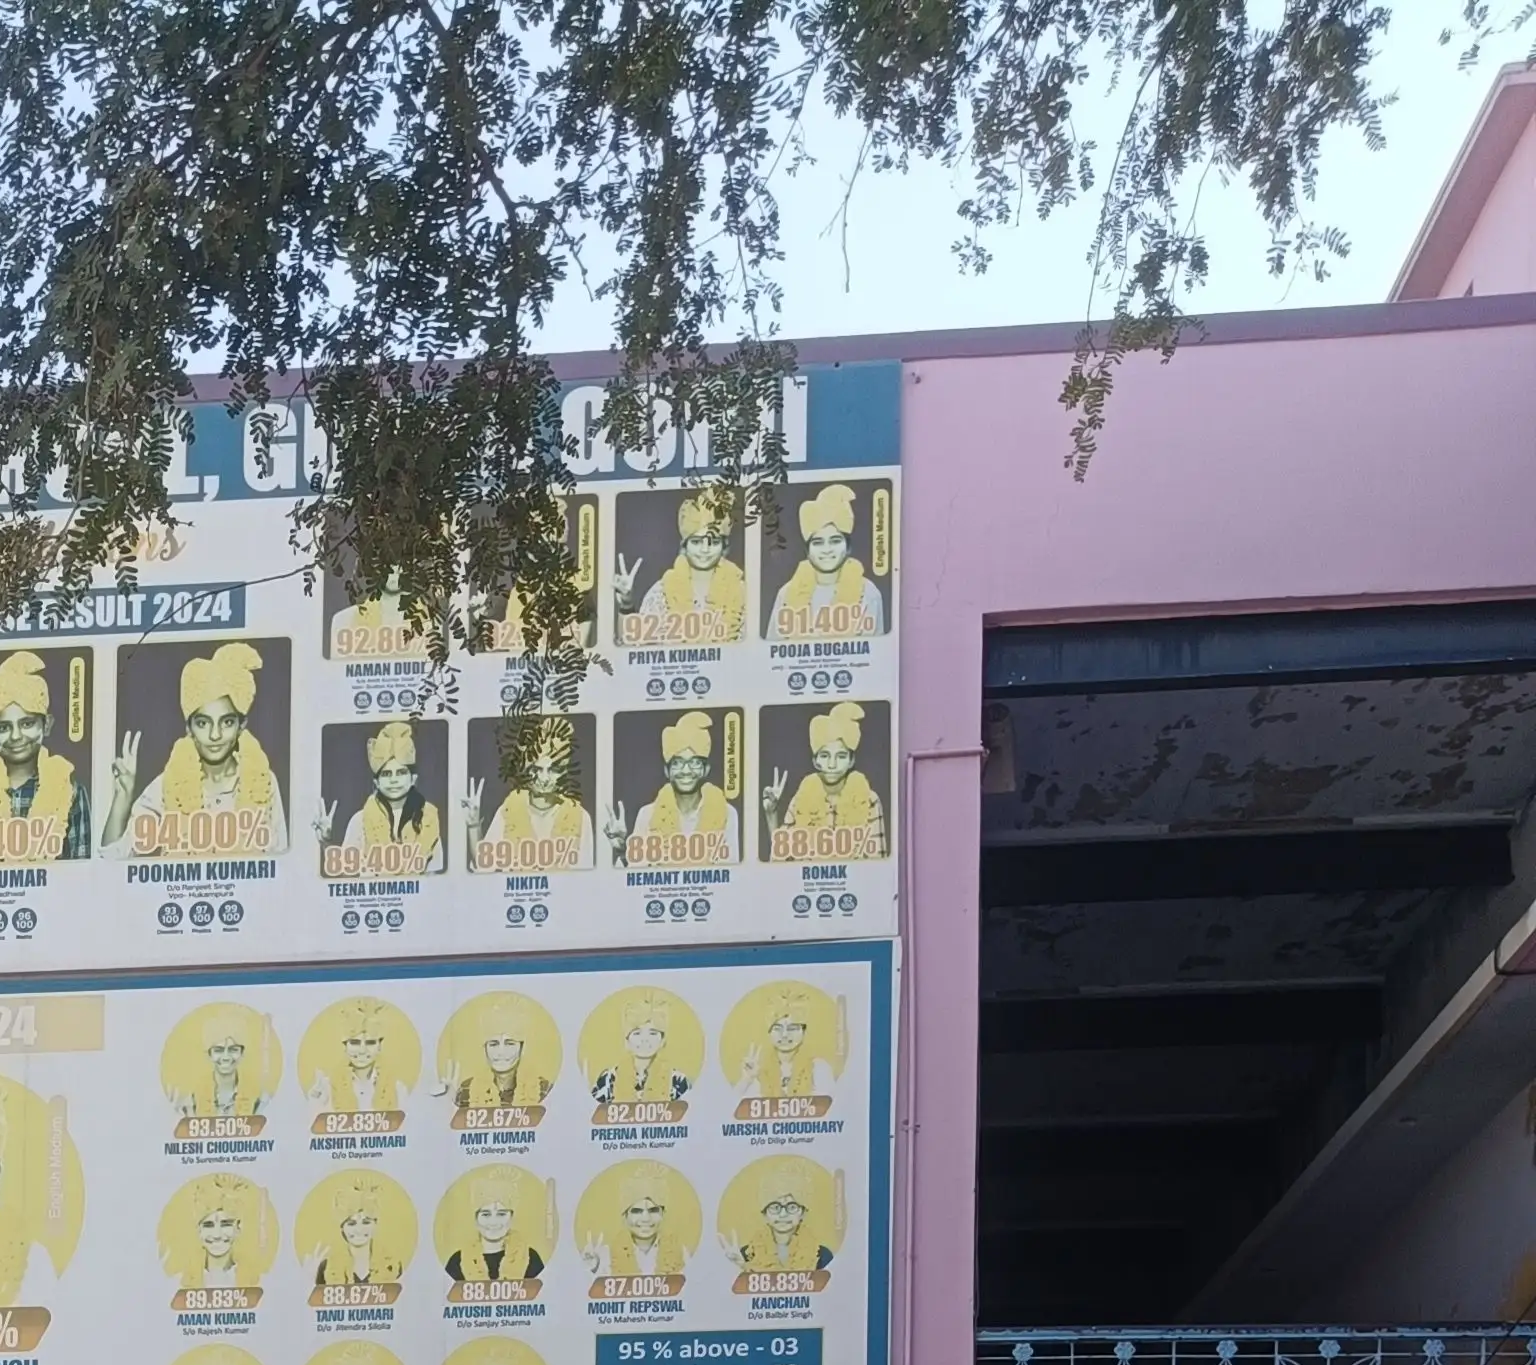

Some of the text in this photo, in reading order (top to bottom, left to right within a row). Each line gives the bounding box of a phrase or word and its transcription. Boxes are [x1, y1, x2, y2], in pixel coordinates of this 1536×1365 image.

[876, 497, 884, 568] English Medium
[152, 591, 231, 625] 2024
[625, 611, 725, 643] 92.20%
[778, 605, 873, 635] 91.40%
[628, 647, 721, 665] PRIYA KUMARI
[770, 641, 870, 658] POOJA BUGALIA
[346, 662, 390, 677] NAMAN
[70, 665, 81, 734] English Medium
[726, 720, 736, 791] English Medium
[134, 810, 270, 852] 94.00%
[628, 832, 729, 863] 88.80%
[773, 827, 876, 858] 88.60%
[324, 843, 424, 874] 89.40%
[477, 838, 578, 869] 89.00%
[128, 860, 276, 883] POONAM KUMARI
[626, 869, 730, 886] HEMANT KUMAR
[802, 865, 847, 880] RONAK
[328, 880, 419, 897] TEENA KUMARI
[506, 876, 549, 890] NIKITA
[466, 1108, 530, 1128] 92.67%
[607, 1103, 672, 1123] 92.00%
[750, 1098, 815, 1118] 91.50%
[460, 1130, 536, 1146] AMIT KUMAR
[591, 1126, 688, 1141] PRERNA KUMARI
[722, 1120, 844, 1136] VARSHA CHOUDHARY
[164, 1139, 275, 1156] NILESH CHOUDHARY
[310, 1135, 406, 1150] AKSHITA KUMARI
[462, 1280, 527, 1300] 88.00%
[604, 1276, 669, 1296] 87.00%
[749, 1271, 814, 1291] 86.83%
[443, 1304, 546, 1319] AAYUSHI SHARMA
[588, 1299, 685, 1315] MOHIT REPSWAL
[751, 1296, 810, 1310] KANCHAN
[177, 1312, 256, 1326] AMAN KUMAR
[316, 1308, 393, 1322] TANU KUMARI
[618, 1337, 799, 1359] 95 above 03
